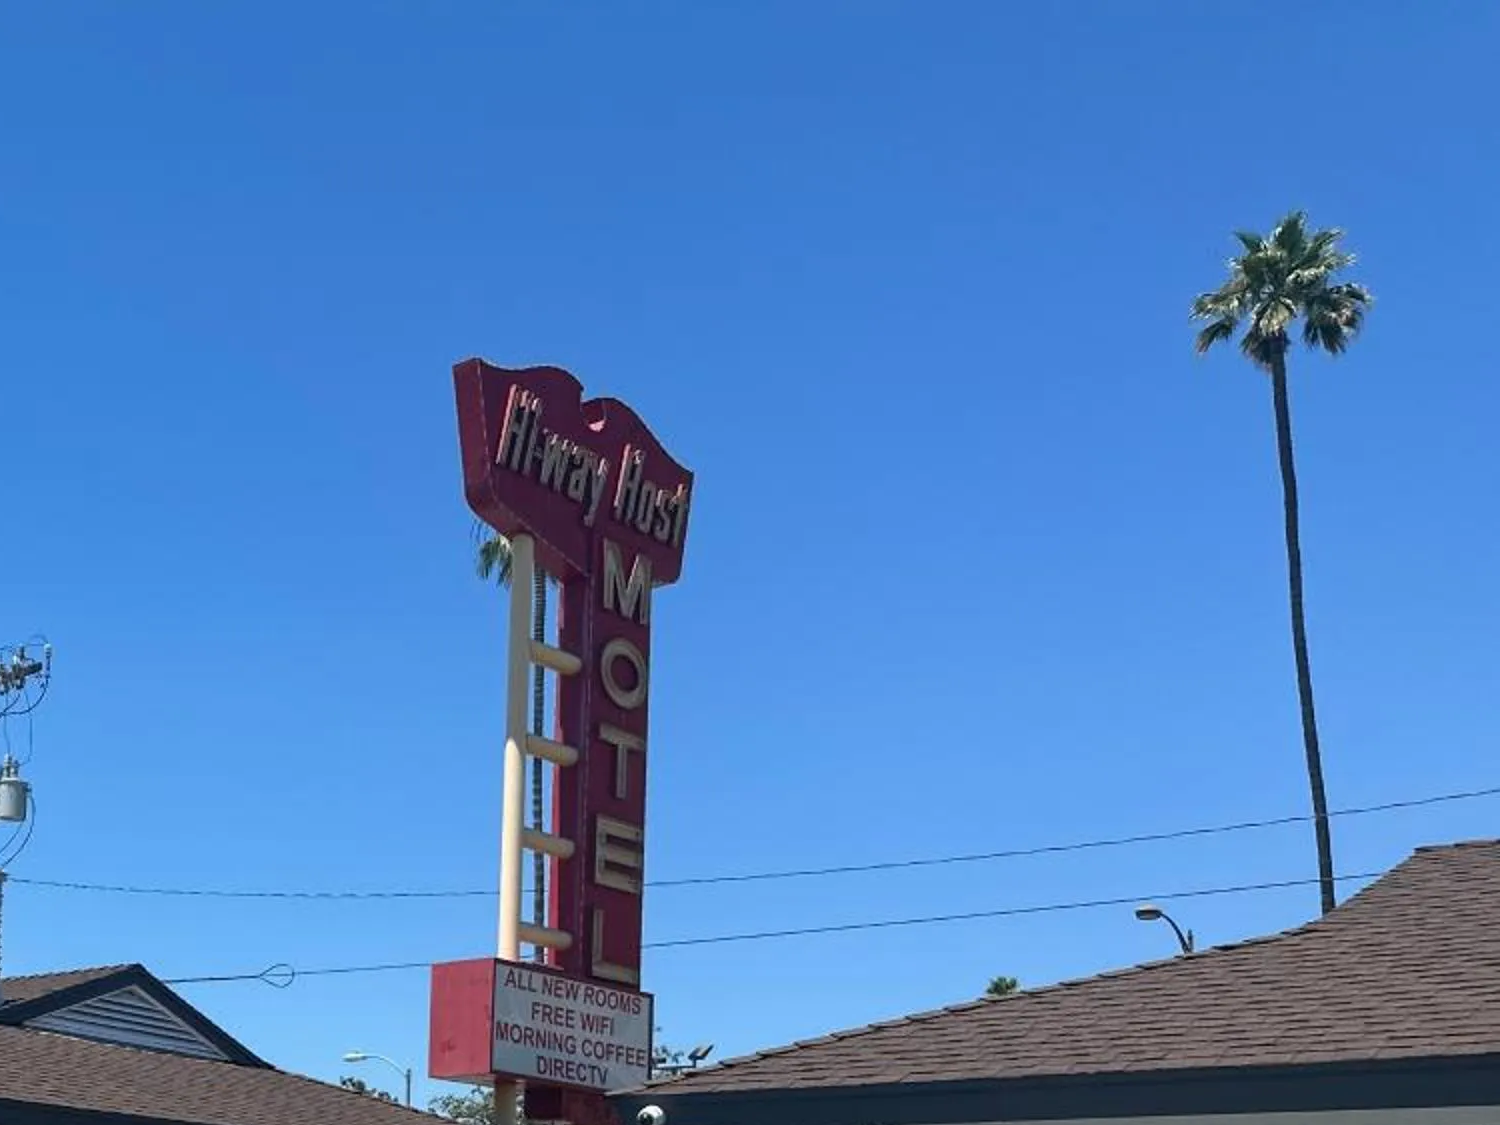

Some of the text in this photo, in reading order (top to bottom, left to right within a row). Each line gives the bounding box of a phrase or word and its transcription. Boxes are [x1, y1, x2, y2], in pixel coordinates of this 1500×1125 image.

[613, 443, 689, 547] Host
[591, 538, 652, 989] MOTEL
[504, 968, 641, 1015] ALL NEW ROOMS
[531, 1001, 615, 1036] FREE WIFI
[496, 1021, 647, 1067] MORNING COFFEE
[537, 1055, 608, 1085] DIRECTV
